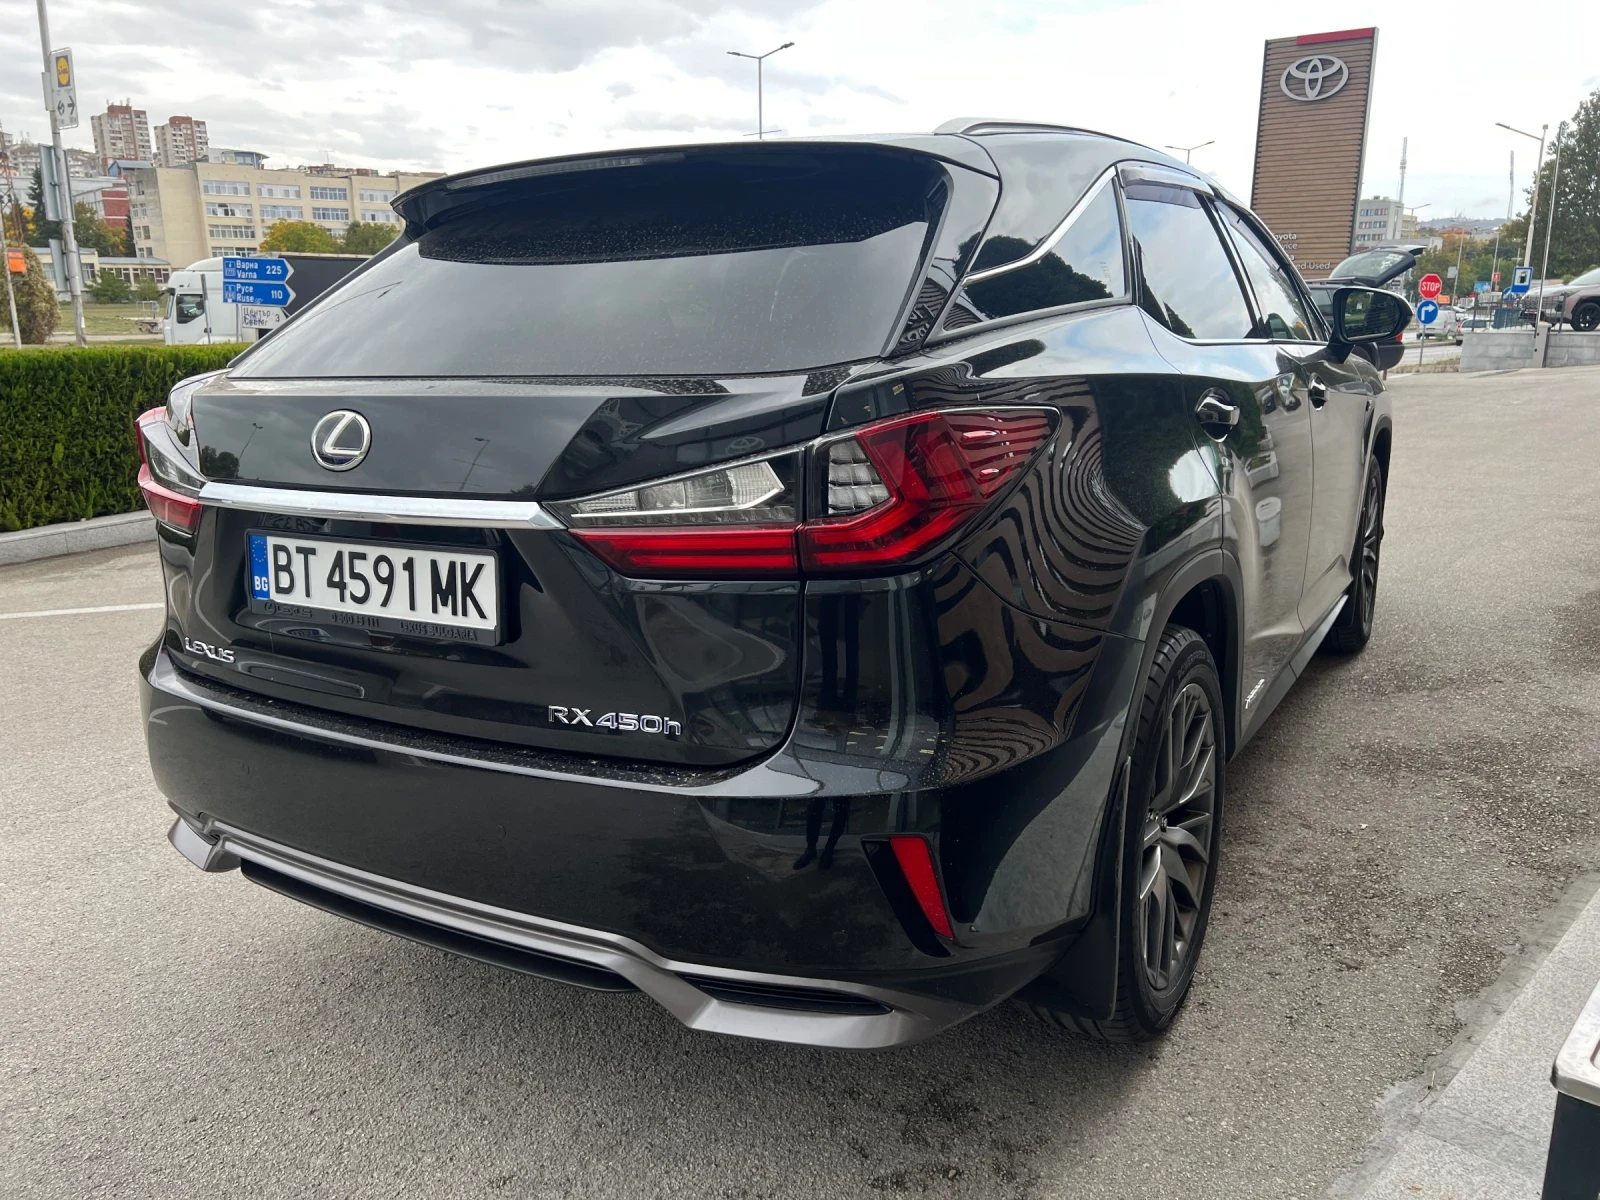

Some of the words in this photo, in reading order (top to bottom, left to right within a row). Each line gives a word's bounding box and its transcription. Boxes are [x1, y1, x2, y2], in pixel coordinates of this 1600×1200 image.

[1273, 233, 1297, 241] oyota
[236, 260, 259, 270] Варна
[265, 265, 282, 275] 225
[1308, 262, 1331, 270] Used
[236, 270, 257, 278] Varna
[236, 283, 254, 294] Русе
[271, 290, 283, 299] 110
[1421, 282, 1441, 292] STOP
[236, 293, 255, 303] Ruse
[243, 307, 271, 318] Център
[275, 313, 280, 322] 3
[253, 575, 269, 592] BG
[272, 543, 317, 598] BT
[326, 549, 416, 612] 4591
[429, 558, 489, 620] MK
[400, 620, 427, 635] LEXUS
[427, 624, 478, 641] BULGARIA
[184, 636, 235, 663] LEXUS
[548, 705, 594, 727] RX
[595, 712, 682, 736] 450h
